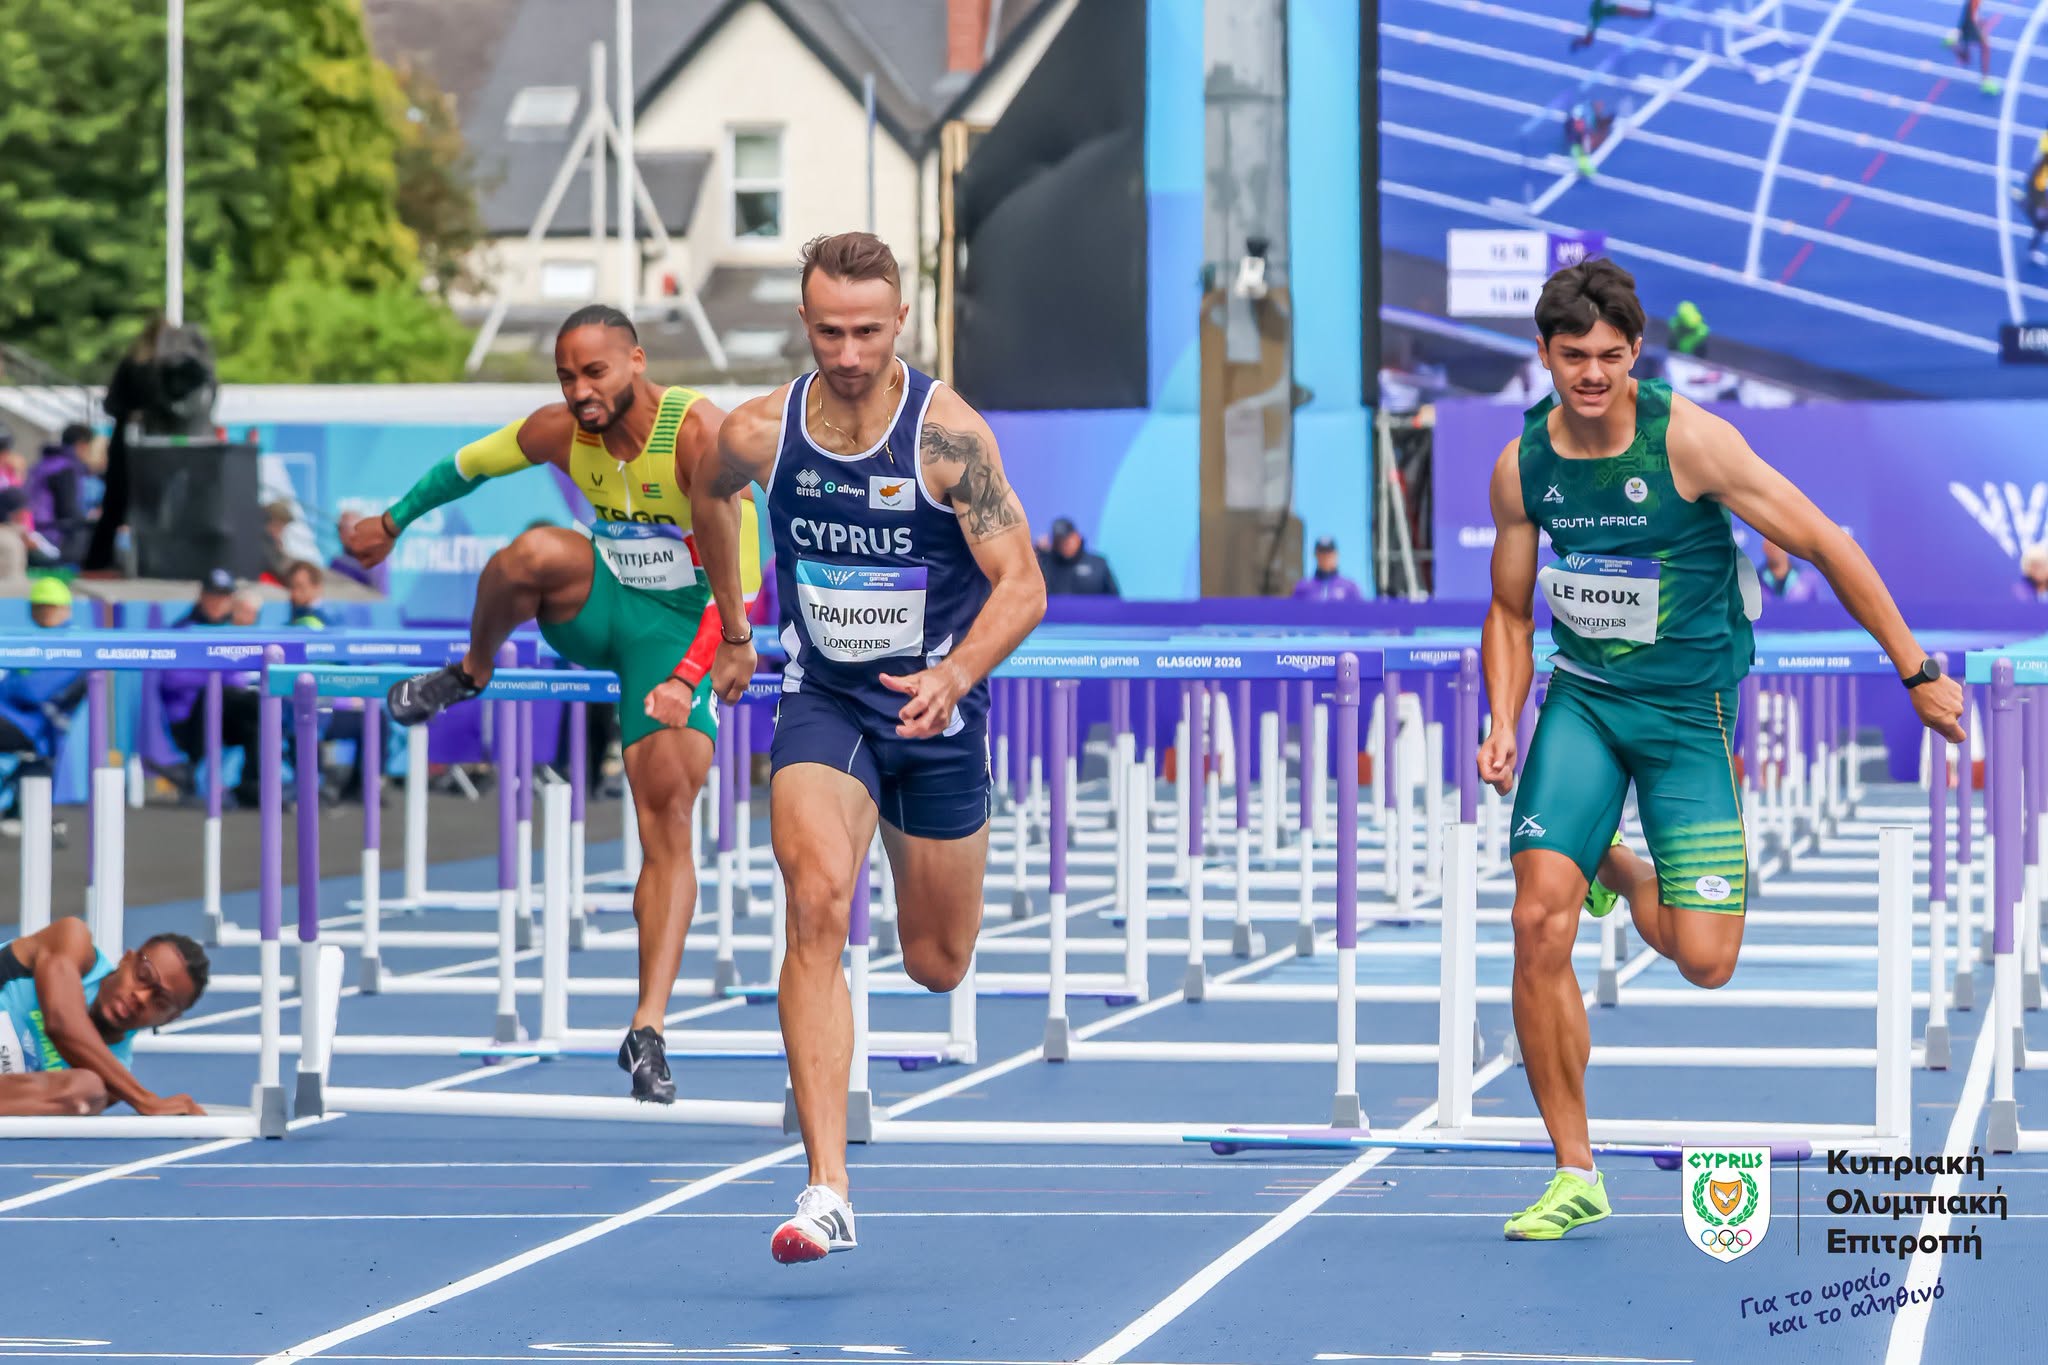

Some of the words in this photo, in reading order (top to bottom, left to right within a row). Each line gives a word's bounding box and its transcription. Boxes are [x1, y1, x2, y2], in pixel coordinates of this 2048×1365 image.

[837, 484, 865, 497] allwyn
[1551, 517, 1595, 529] SOUTH
[1600, 515, 1648, 527] AFRICA
[790, 517, 913, 555] CYPRUS
[1552, 583, 1575, 601] LE
[1581, 588, 1641, 607] ROUX
[809, 603, 909, 628] TRAJKOVIC
[823, 636, 891, 649] LONGINES
[1010, 655, 1097, 667] commonwealth
[1100, 656, 1140, 669] games
[1156, 656, 1212, 668] GLASGOW
[1214, 656, 1242, 668] 2026
[1276, 654, 1336, 667] LONGINES
[551, 680, 590, 693] games
